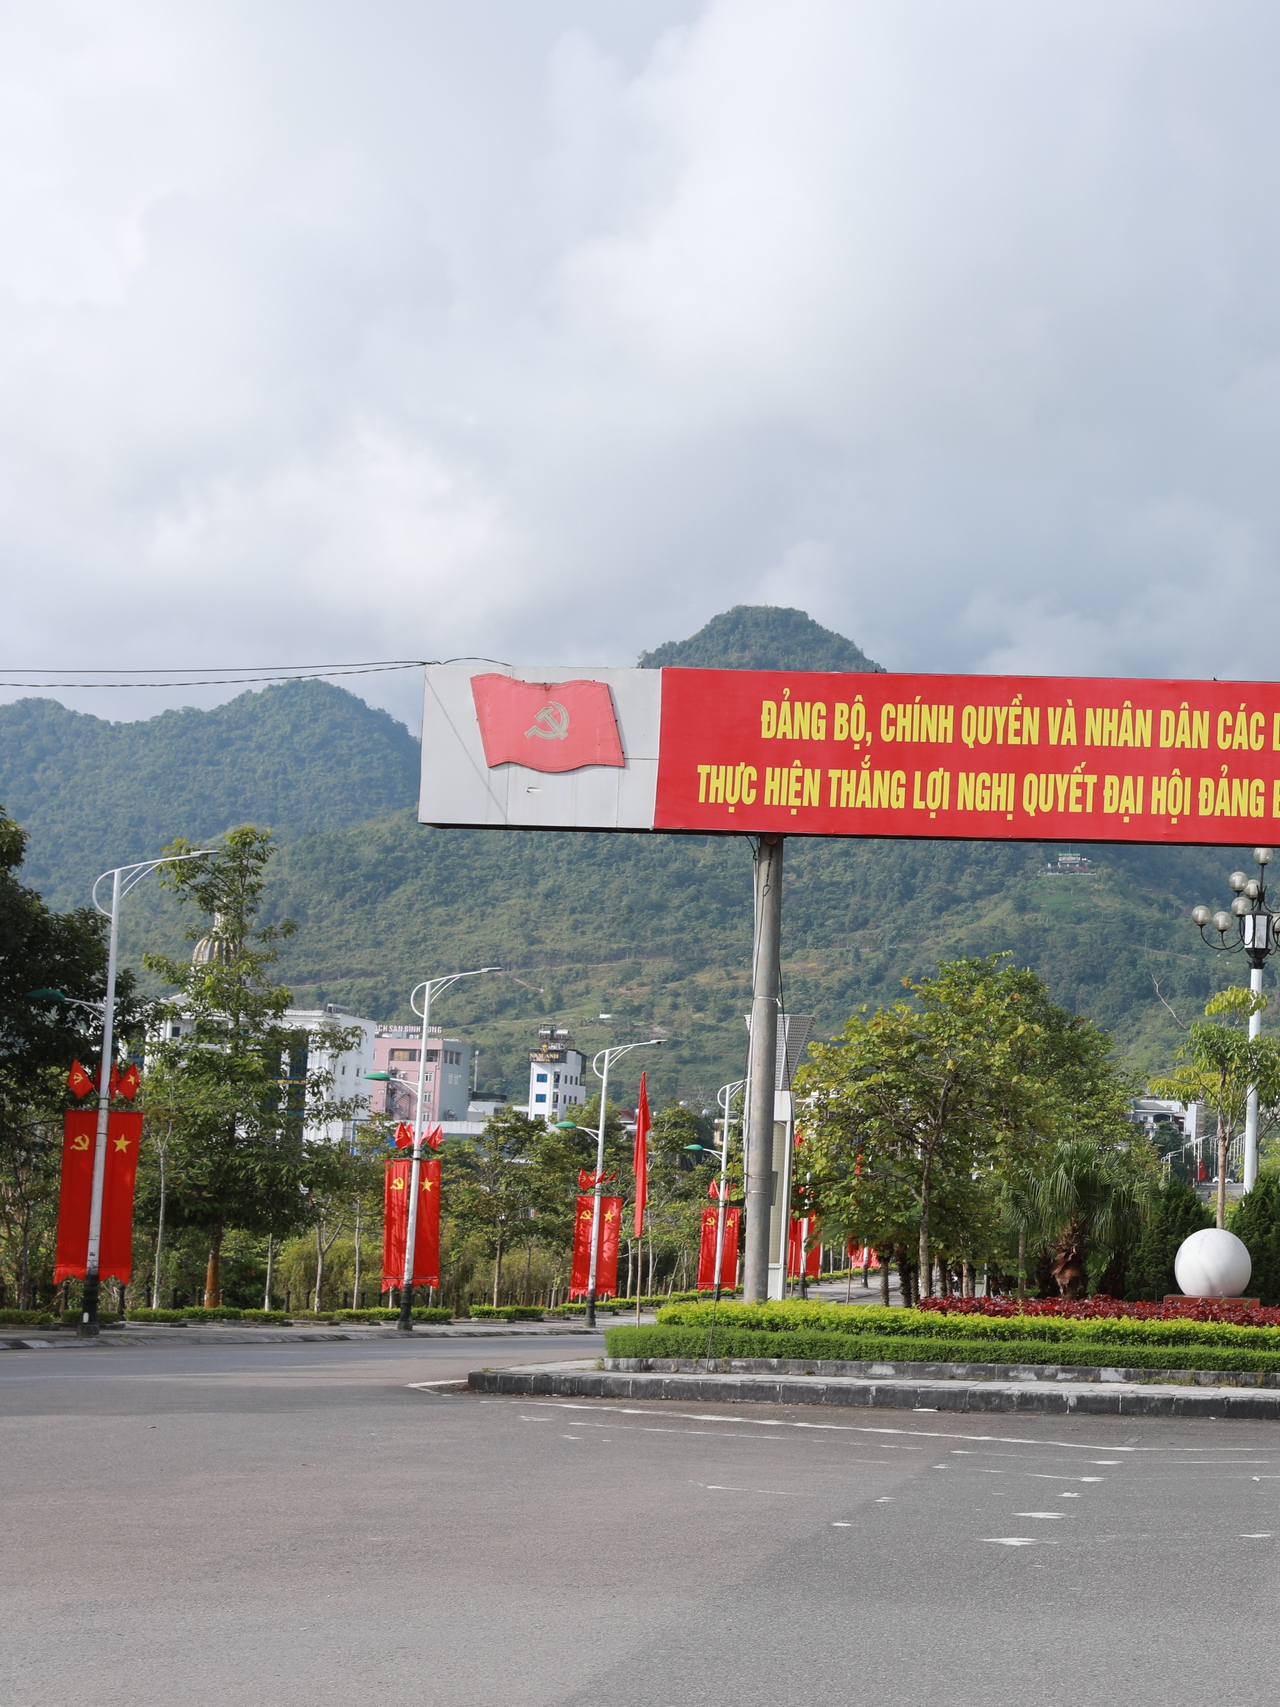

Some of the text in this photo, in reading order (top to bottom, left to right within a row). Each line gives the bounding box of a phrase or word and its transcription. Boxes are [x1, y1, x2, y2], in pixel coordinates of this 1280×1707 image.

[761, 688, 826, 740] ĐẢNG
[834, 695, 872, 750] BỘ,
[881, 696, 954, 743] CHÍNH
[962, 694, 1040, 748] QUYỀN
[1048, 700, 1077, 745] VÀ
[1085, 701, 1152, 747] NHÂN
[1160, 702, 1209, 748] DÂN
[1218, 704, 1265, 750] CÁC
[698, 762, 757, 812] THỰC
[764, 760, 820, 814] HIỆN
[829, 755, 906, 808] THẮNG
[914, 768, 950, 818] LỢI
[958, 772, 1015, 820] NGHỊ
[1023, 762, 1097, 816] QUYẾT
[1104, 775, 1144, 822] ĐẠI
[1151, 769, 1191, 824] HỘI
[1198, 765, 1265, 817] ĐẢNG
